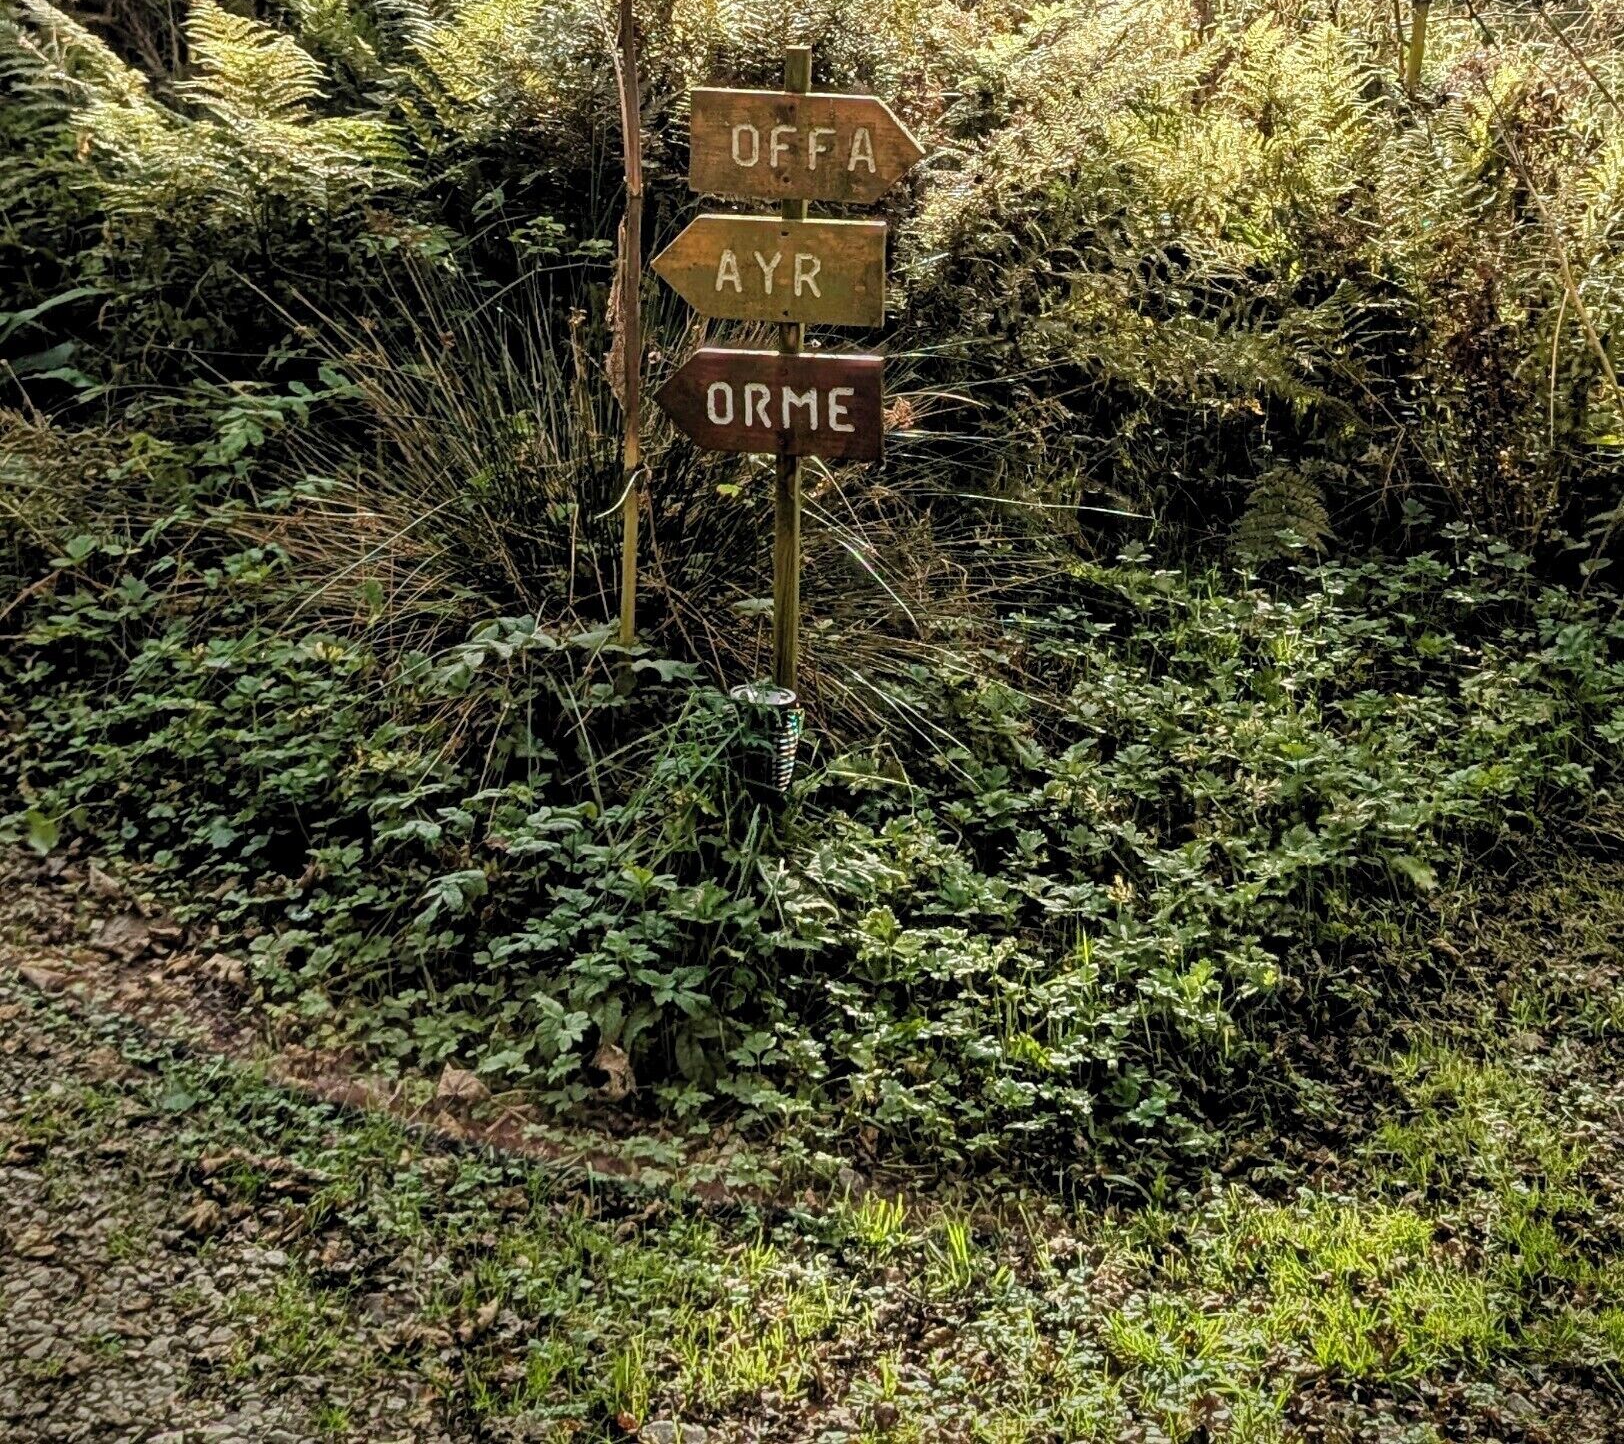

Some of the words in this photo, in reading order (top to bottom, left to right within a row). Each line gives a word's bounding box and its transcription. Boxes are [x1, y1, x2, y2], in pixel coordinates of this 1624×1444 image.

[731, 123, 876, 174] OFFA
[715, 249, 821, 298] AYR
[706, 381, 855, 432] ORME
